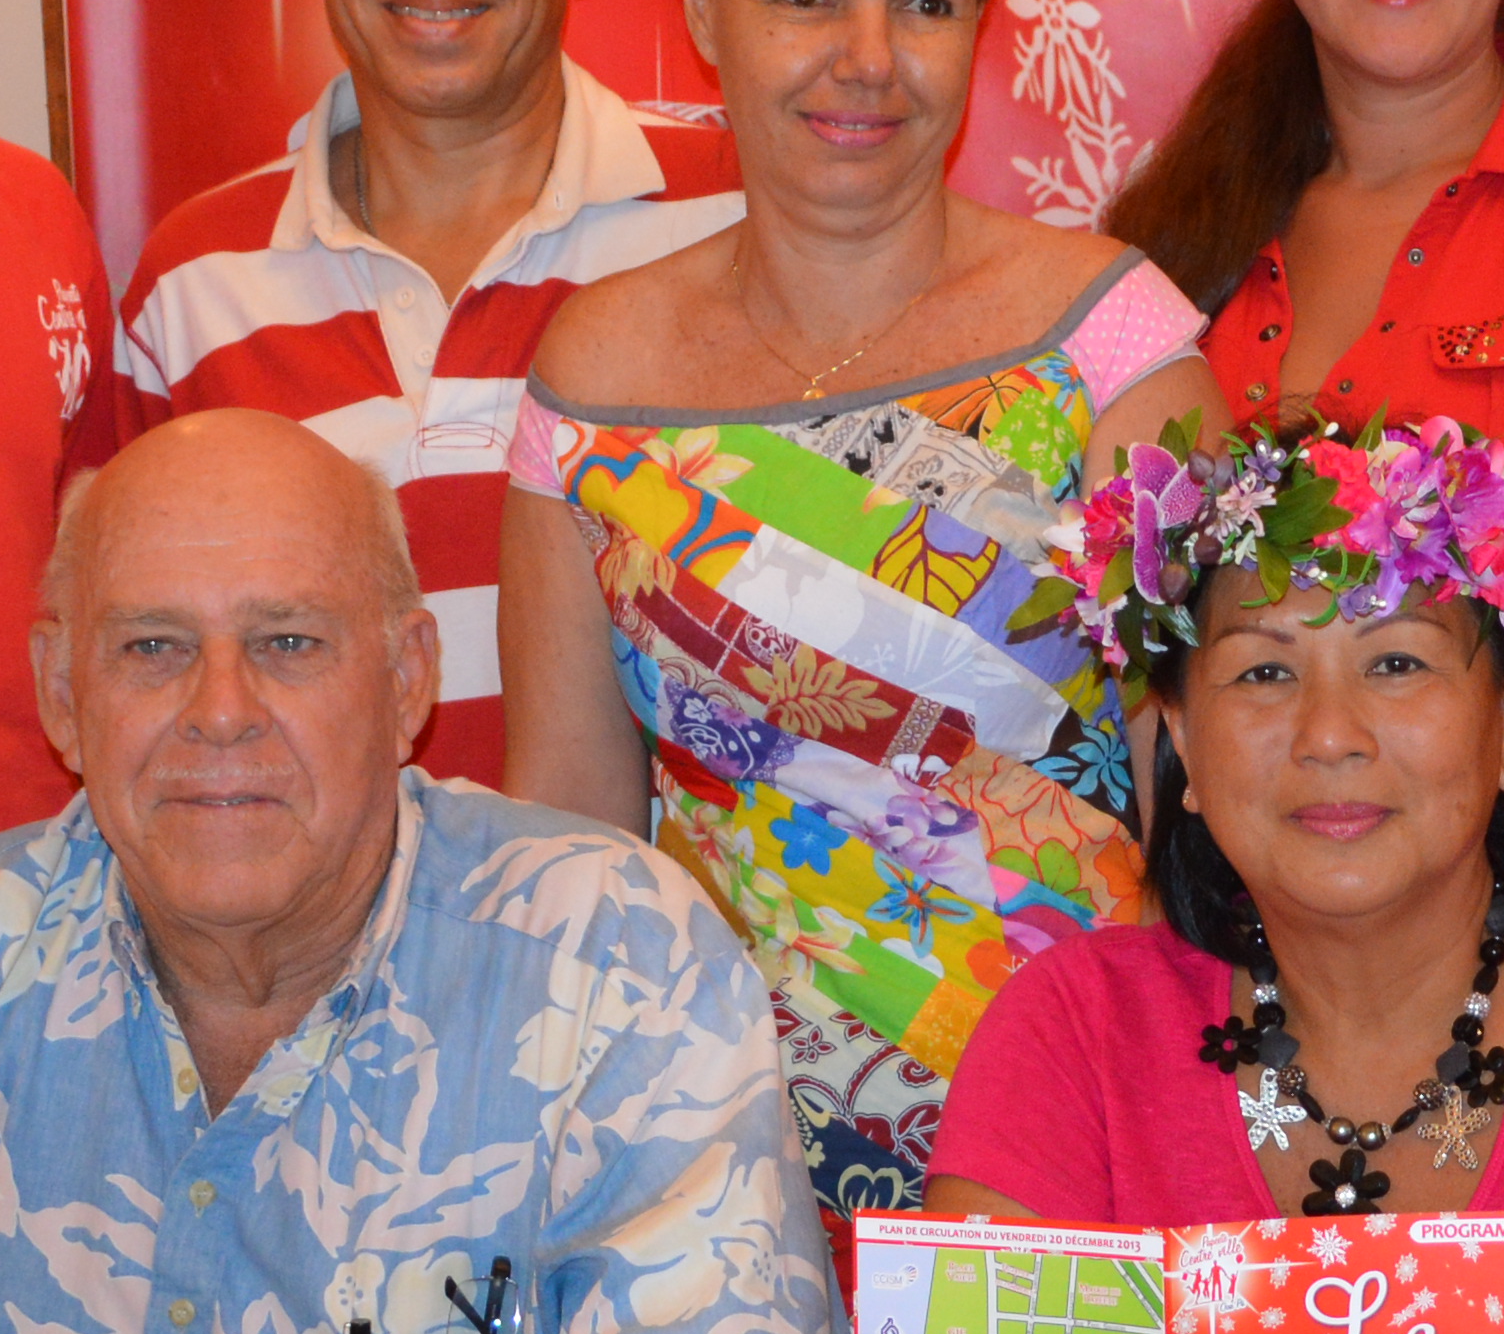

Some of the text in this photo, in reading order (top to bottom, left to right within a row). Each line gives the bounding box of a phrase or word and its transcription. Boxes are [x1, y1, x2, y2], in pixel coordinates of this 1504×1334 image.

[879, 1225, 1141, 1252] PLAN DE CIRCULATION DU VENDREDI 20 DÉCEMBRE 2013
